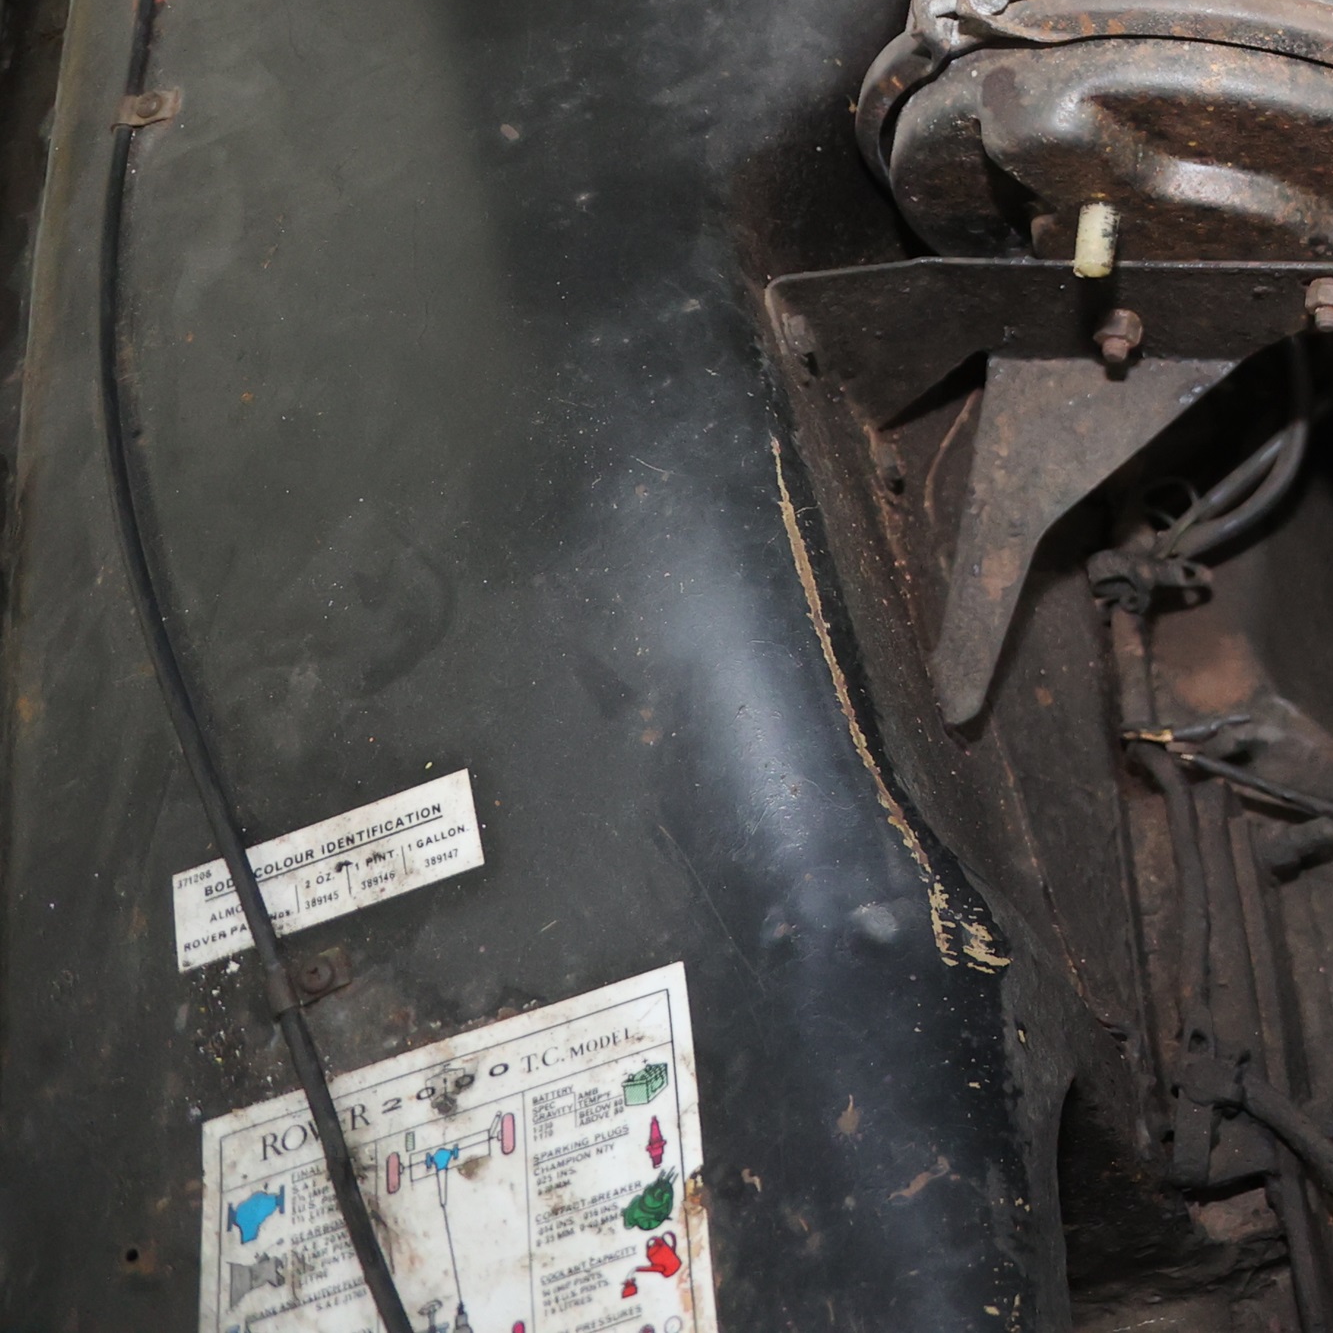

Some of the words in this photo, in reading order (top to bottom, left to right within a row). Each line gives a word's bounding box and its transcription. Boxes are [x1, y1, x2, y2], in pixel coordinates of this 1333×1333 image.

[204, 879, 235, 897] BOD
[253, 849, 315, 879] COLOUR
[321, 803, 442, 856] IDENTIFICATION
[183, 930, 227, 953] ROVER
[304, 890, 340, 911] 389145
[360, 871, 396, 891] 389146
[424, 848, 460, 868] 389147
[209, 903, 244, 923] ALMO
[261, 1103, 370, 1160] ROVR
[570, 1026, 634, 1058] MODEL
[532, 1085, 574, 1104] BATTERY
[532, 1101, 556, 1115] SPEC
[578, 1088, 598, 1100] AMB
[532, 1104, 574, 1124] GRAVITY
[579, 1102, 611, 1119] BELOW
[579, 1111, 610, 1126] ABOVE
[533, 1138, 589, 1163] SPARKING
[594, 1124, 630, 1141] PLUGS
[533, 1151, 591, 1177] CHAMPION
